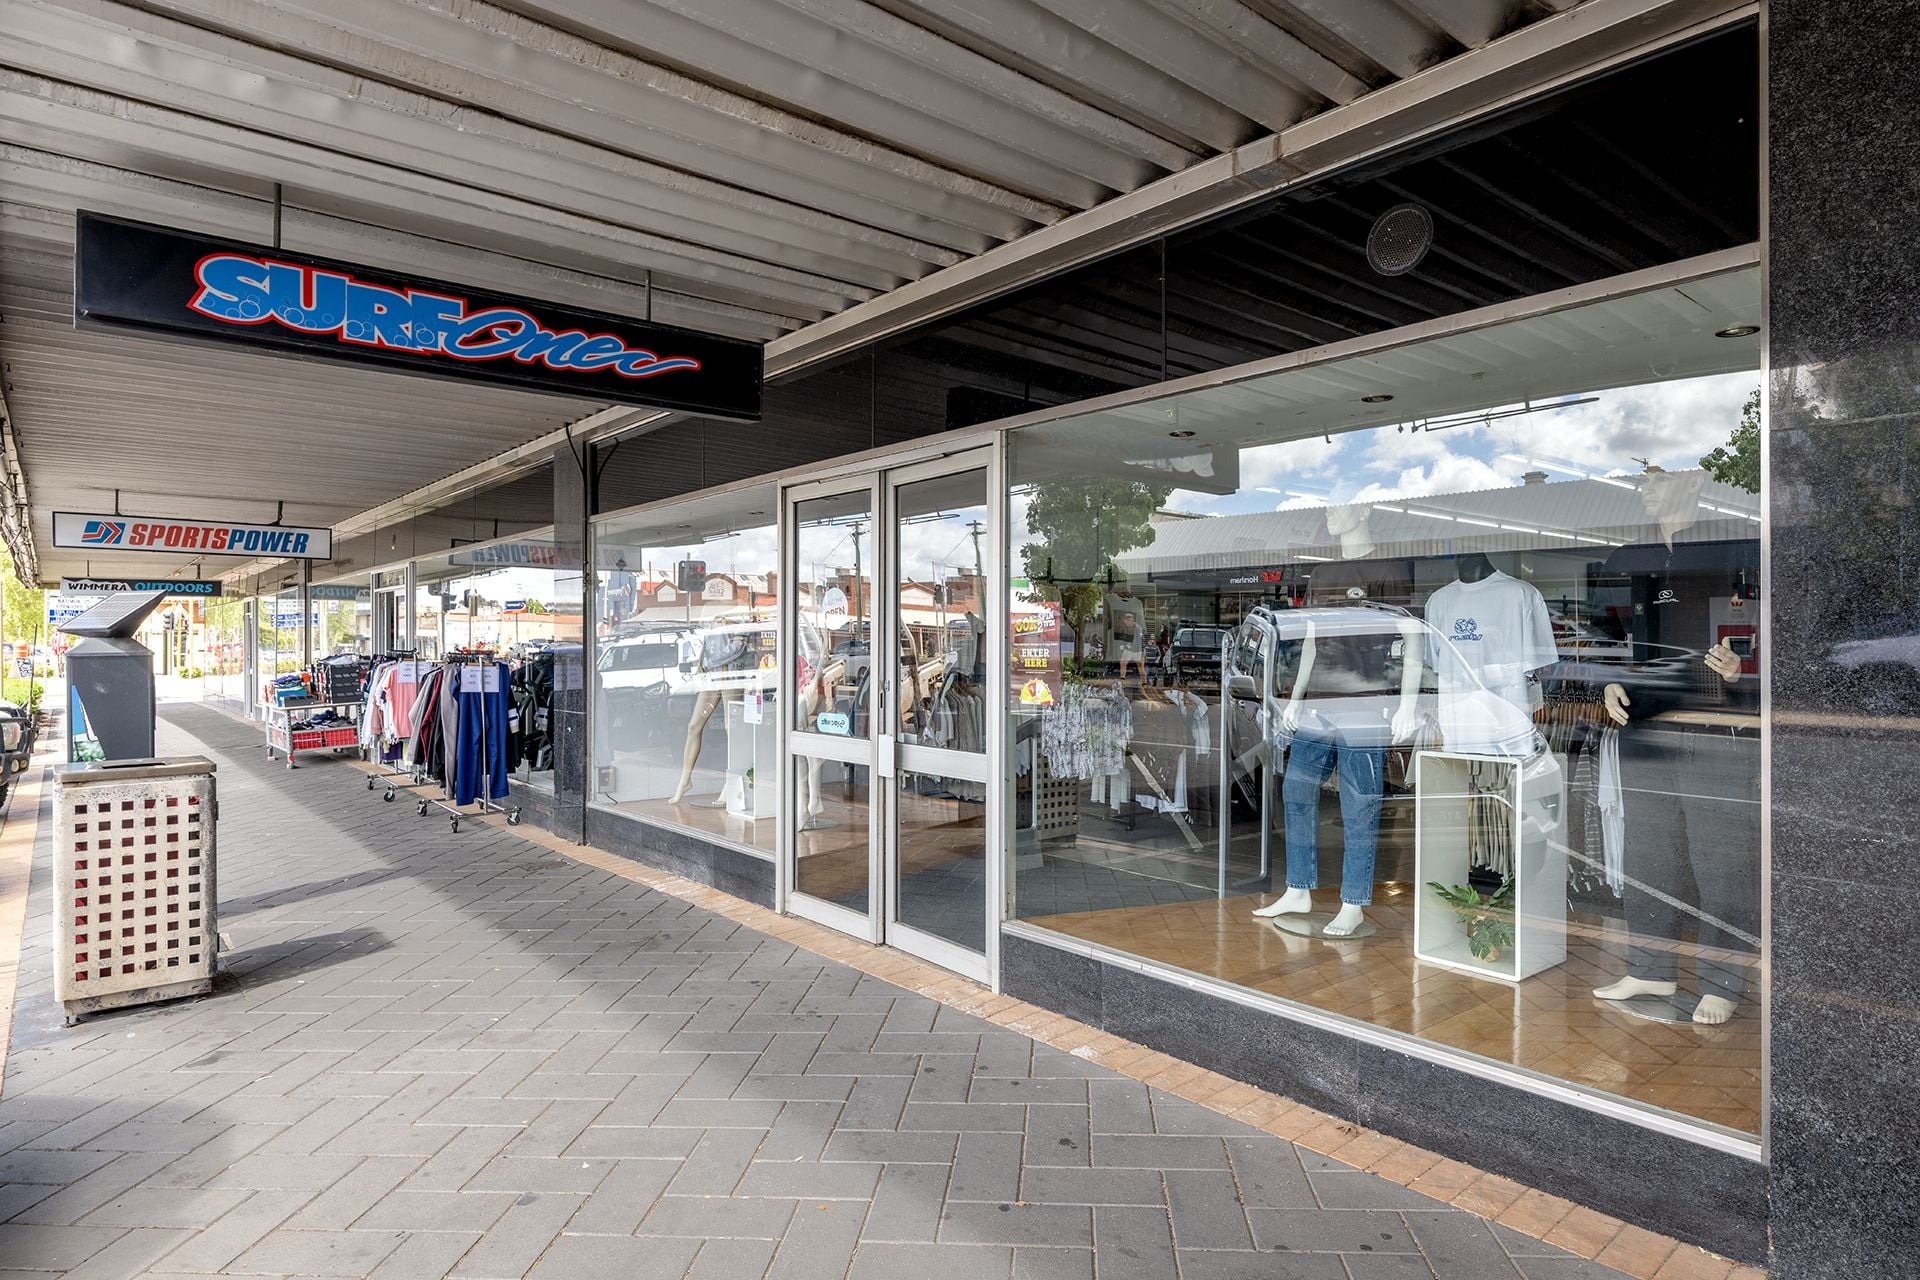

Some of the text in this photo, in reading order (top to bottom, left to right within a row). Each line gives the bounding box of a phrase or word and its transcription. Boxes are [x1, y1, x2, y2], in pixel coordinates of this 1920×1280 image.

[129, 523, 310, 554] SPORTSPOWER
[67, 582, 214, 594] WIMMERA OUTDOORS
[1021, 647, 1050, 658] ENTER
[1023, 658, 1048, 668] HERE
